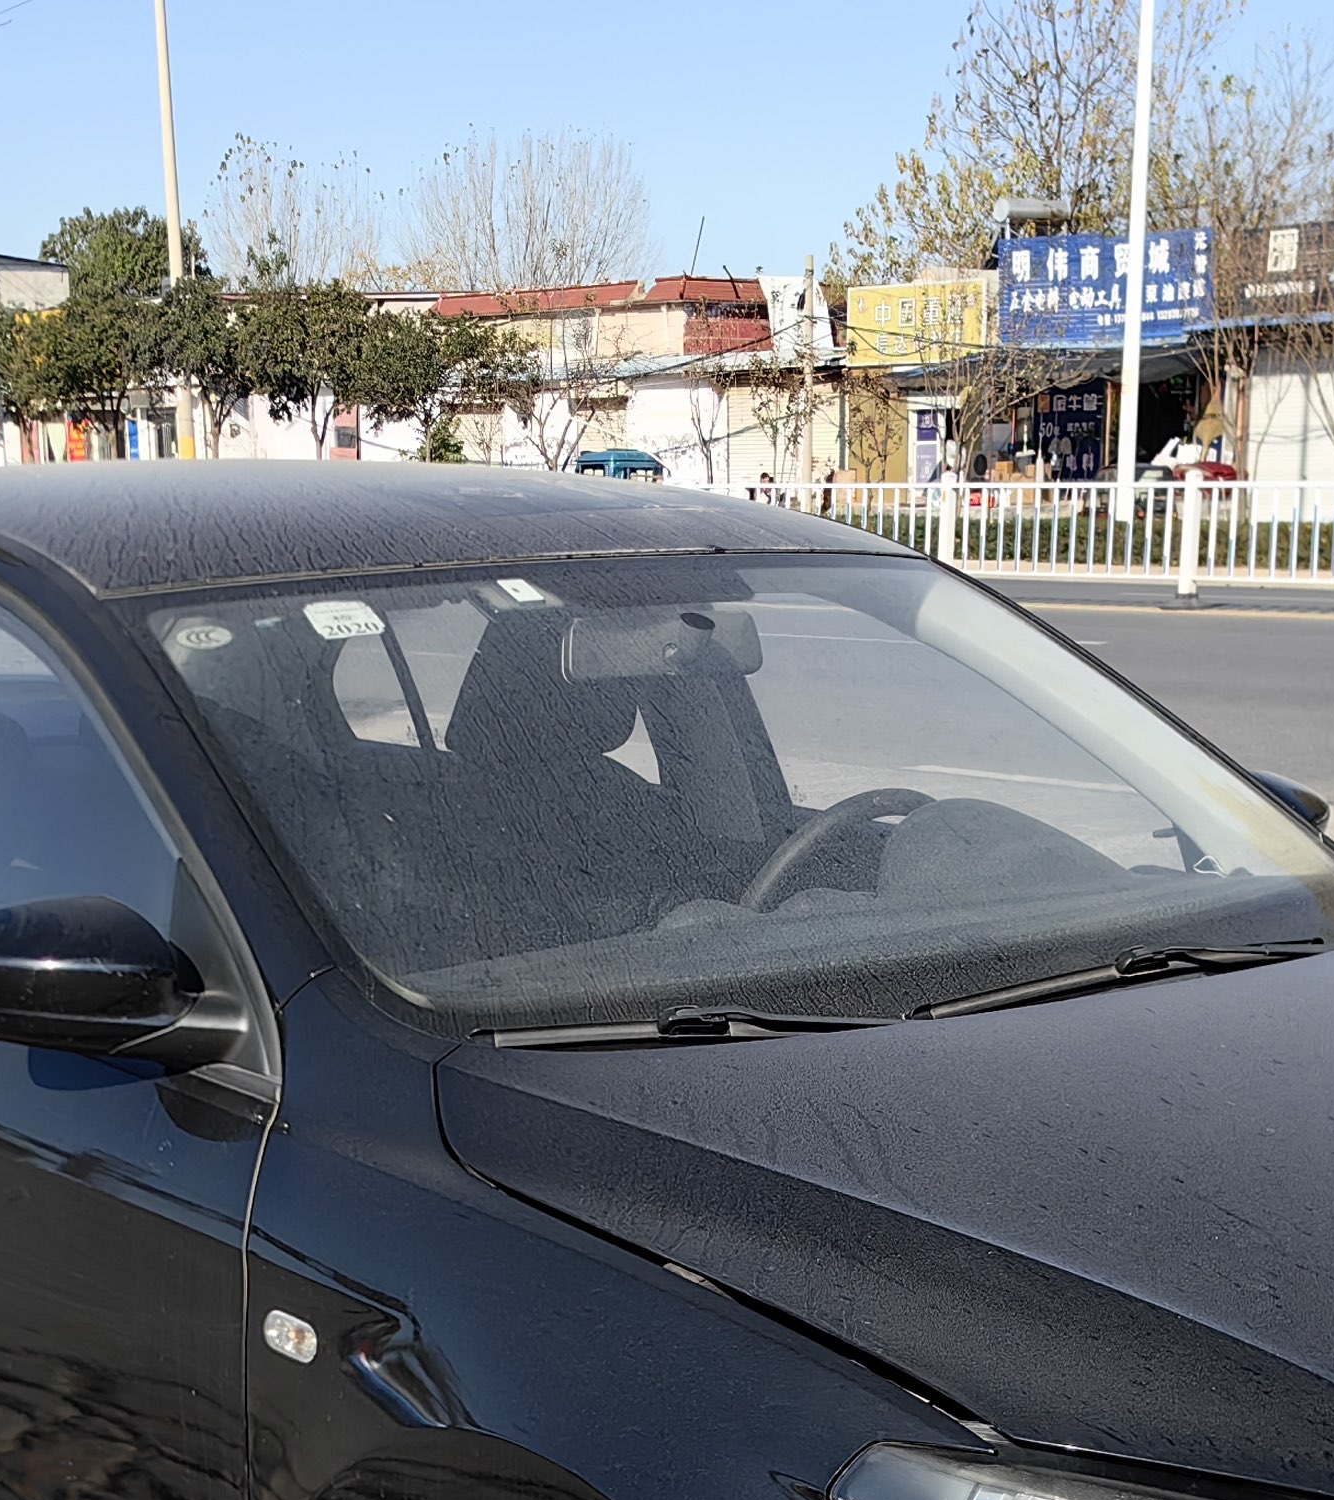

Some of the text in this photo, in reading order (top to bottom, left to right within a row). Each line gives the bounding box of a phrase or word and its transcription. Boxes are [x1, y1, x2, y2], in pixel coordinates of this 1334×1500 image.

[1011, 238, 1171, 282] 明伟商贸城
[322, 621, 379, 636] 2020
